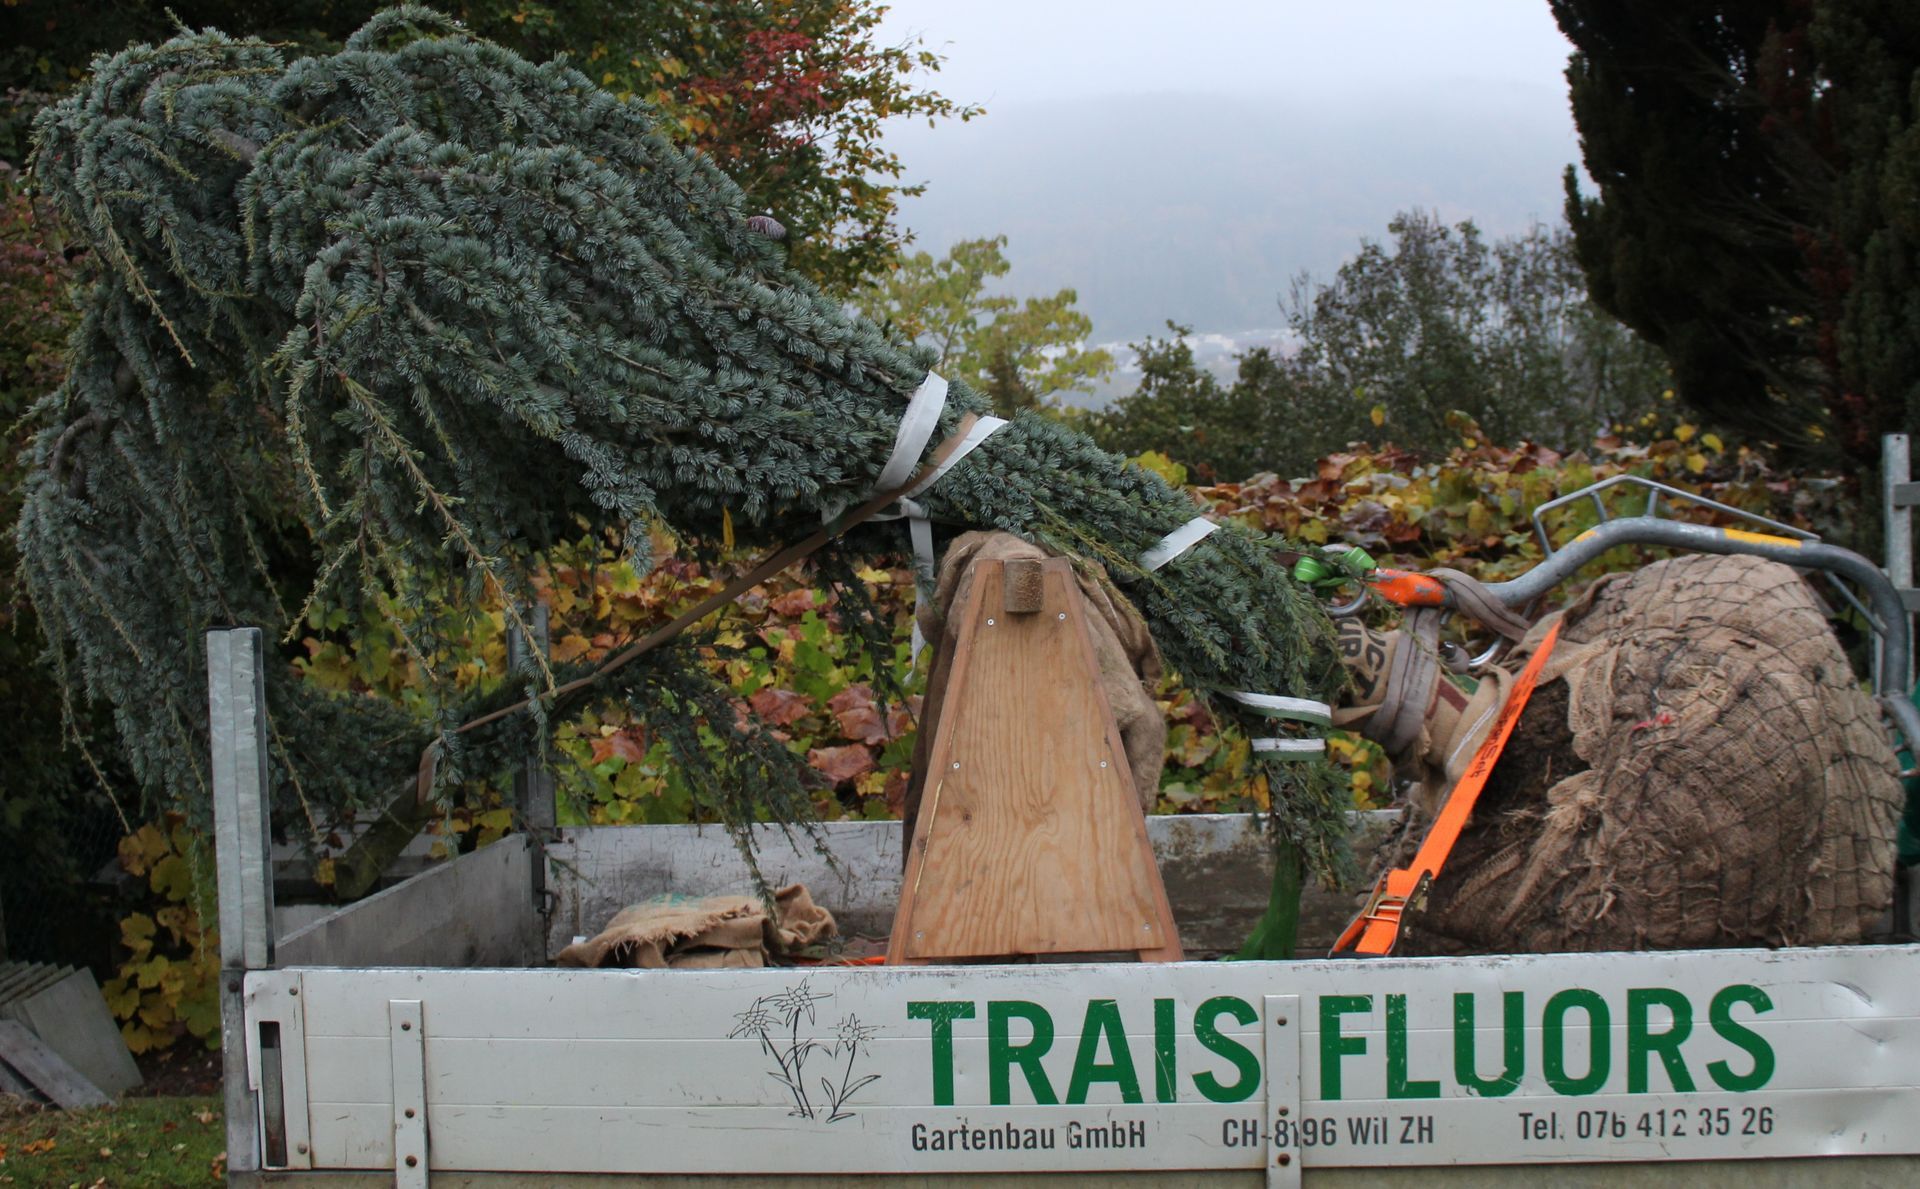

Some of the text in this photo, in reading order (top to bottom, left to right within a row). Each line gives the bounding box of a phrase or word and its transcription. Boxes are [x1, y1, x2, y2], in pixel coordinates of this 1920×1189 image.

[907, 984, 1776, 1105] TRAIS FLUORS
[912, 1119, 1146, 1150] Gartenbau GmbH
[1222, 1115, 1433, 1148] CH-8196 Wil ZH
[1519, 1106, 1774, 1140] Tel. 076 412 35 26
